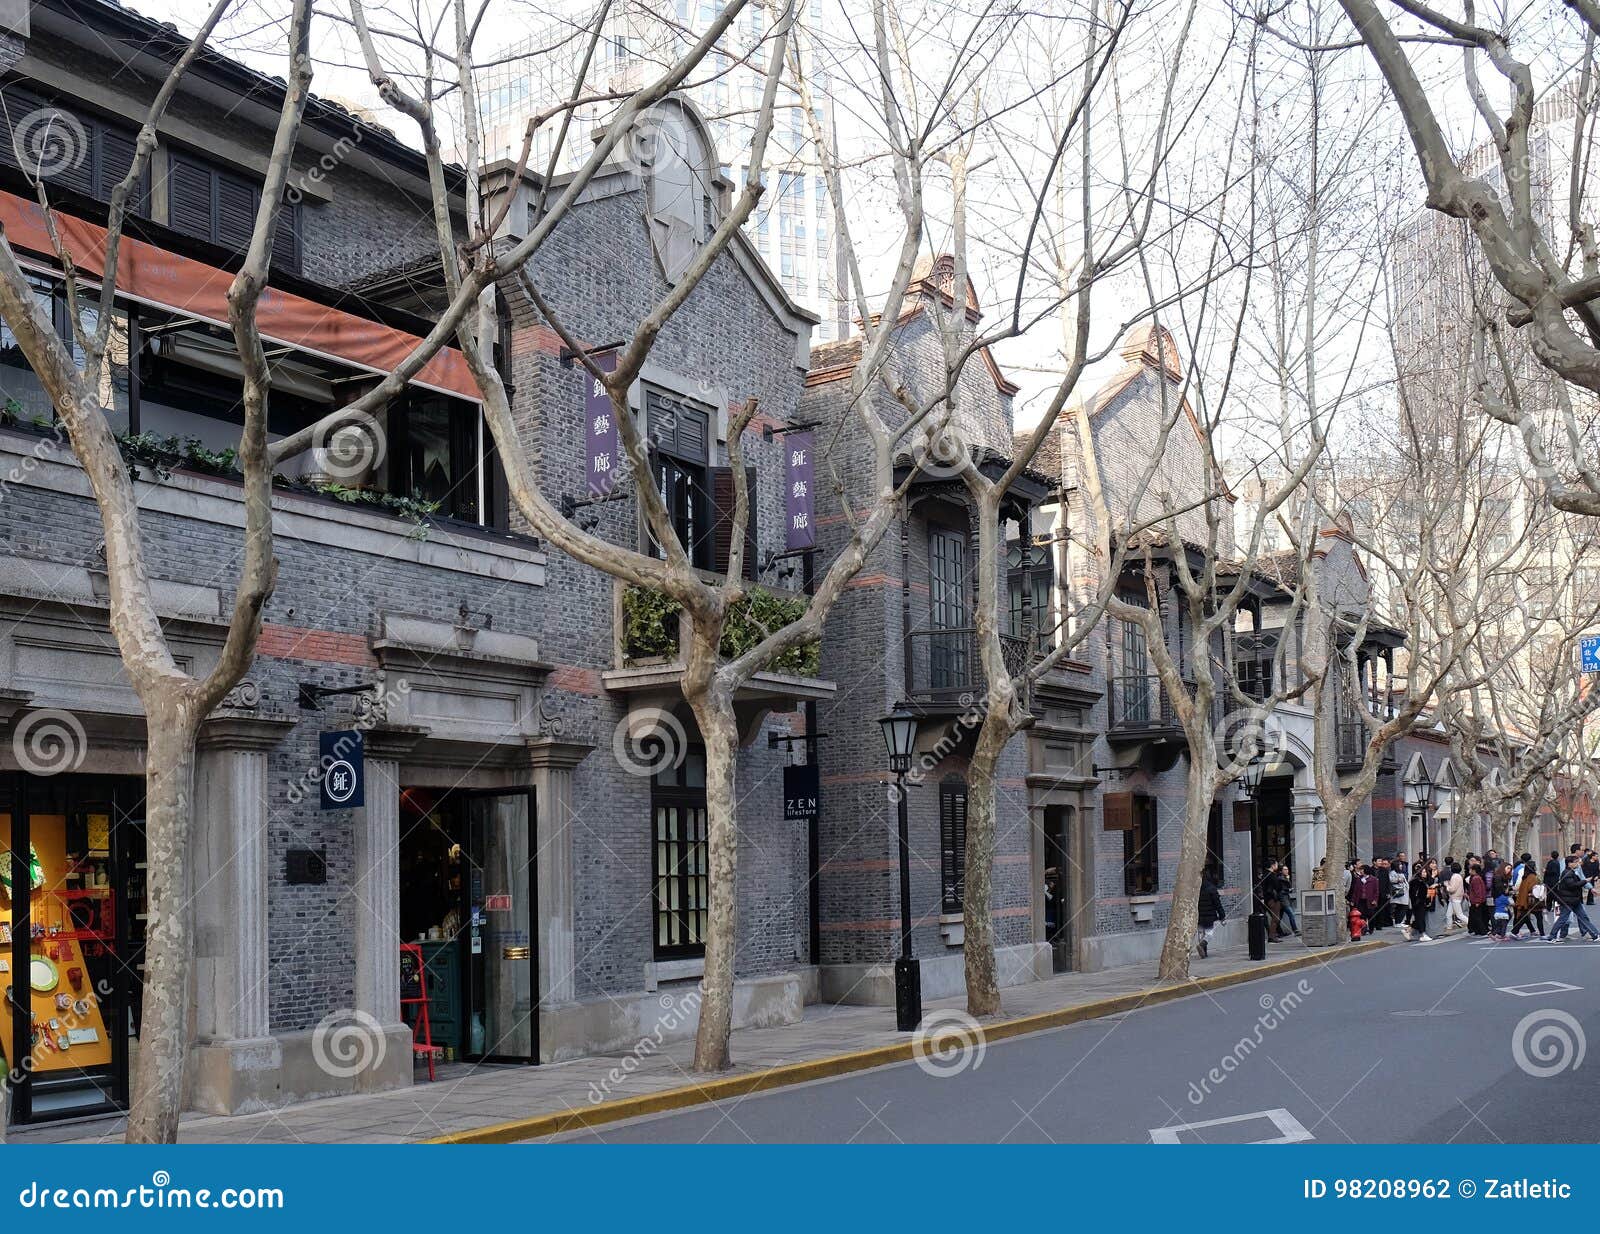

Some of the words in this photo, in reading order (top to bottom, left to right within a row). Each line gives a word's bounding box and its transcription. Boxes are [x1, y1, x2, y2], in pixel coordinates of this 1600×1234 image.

[1582, 639, 1597, 648] 373
[1583, 662, 1598, 671] 374
[787, 798, 816, 809] ZEN
[787, 808, 817, 816] lifestore
